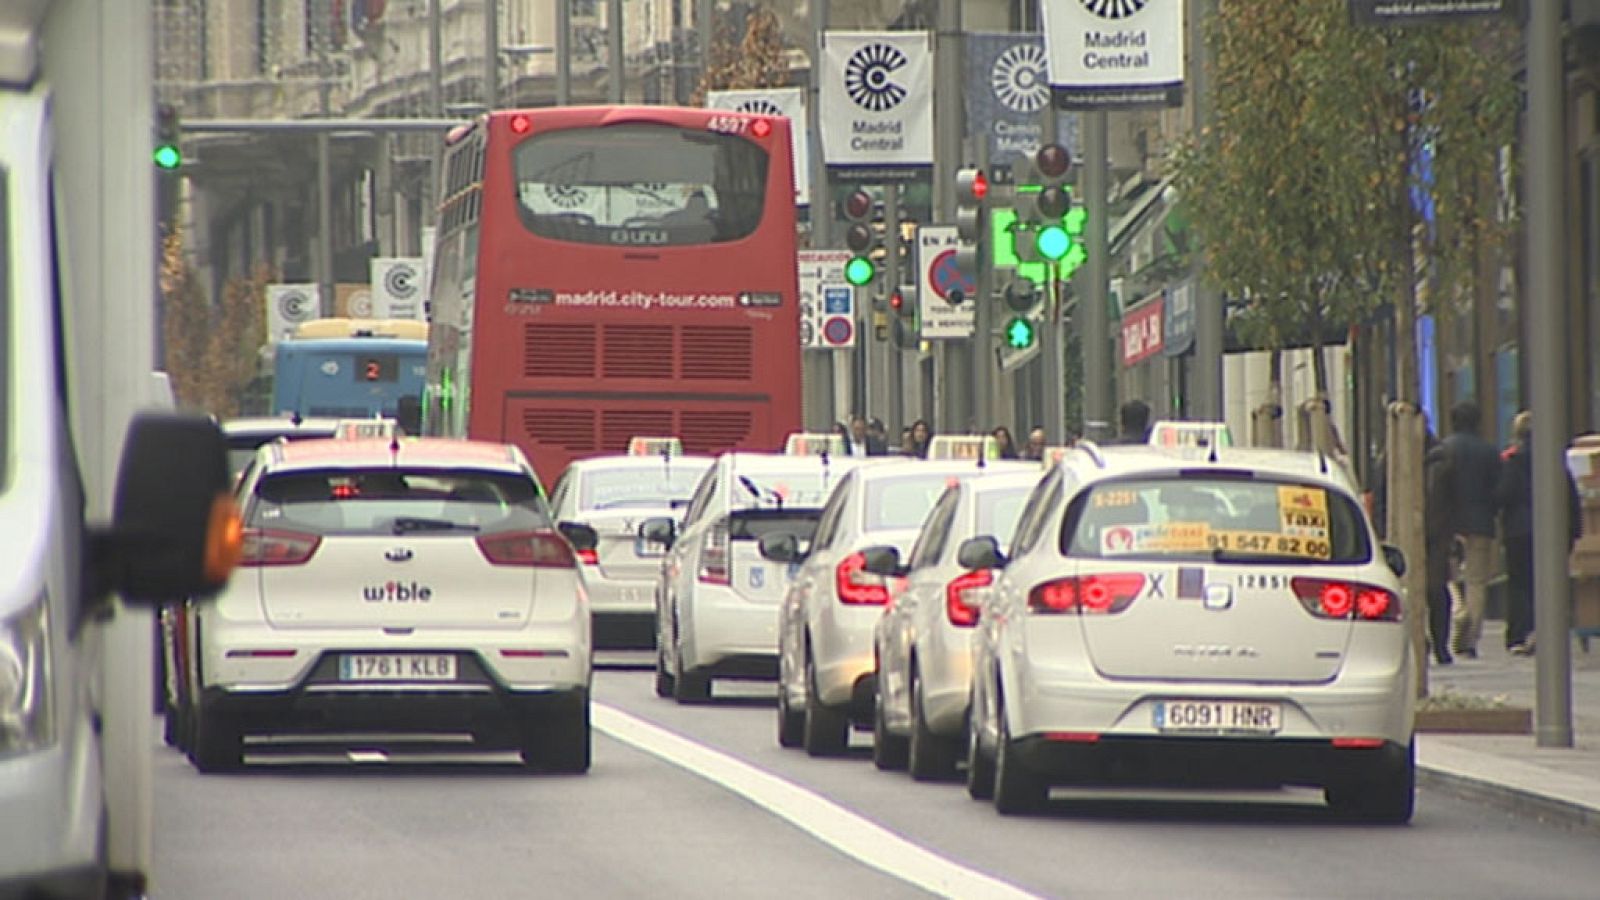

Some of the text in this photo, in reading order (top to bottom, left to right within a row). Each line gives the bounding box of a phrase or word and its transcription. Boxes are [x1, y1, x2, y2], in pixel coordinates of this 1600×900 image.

[1084, 31, 1146, 48] Madrid
[1083, 50, 1149, 69] Central
[707, 115, 750, 133] 4597
[852, 119, 903, 134] Madrid
[851, 136, 904, 151] Central
[797, 252, 852, 263] RECAUCIÓN
[555, 290, 735, 310] madrid.city-tour.com
[366, 361, 380, 380] 2
[1237, 535, 1271, 550] 547
[1278, 538, 1301, 553] 82
[1306, 540, 1329, 557] 00
[363, 580, 432, 602] wible
[1147, 573, 1289, 598] X 12851
[355, 656, 449, 676] 1761 KLB
[1170, 704, 1273, 726] 6091 HNR
